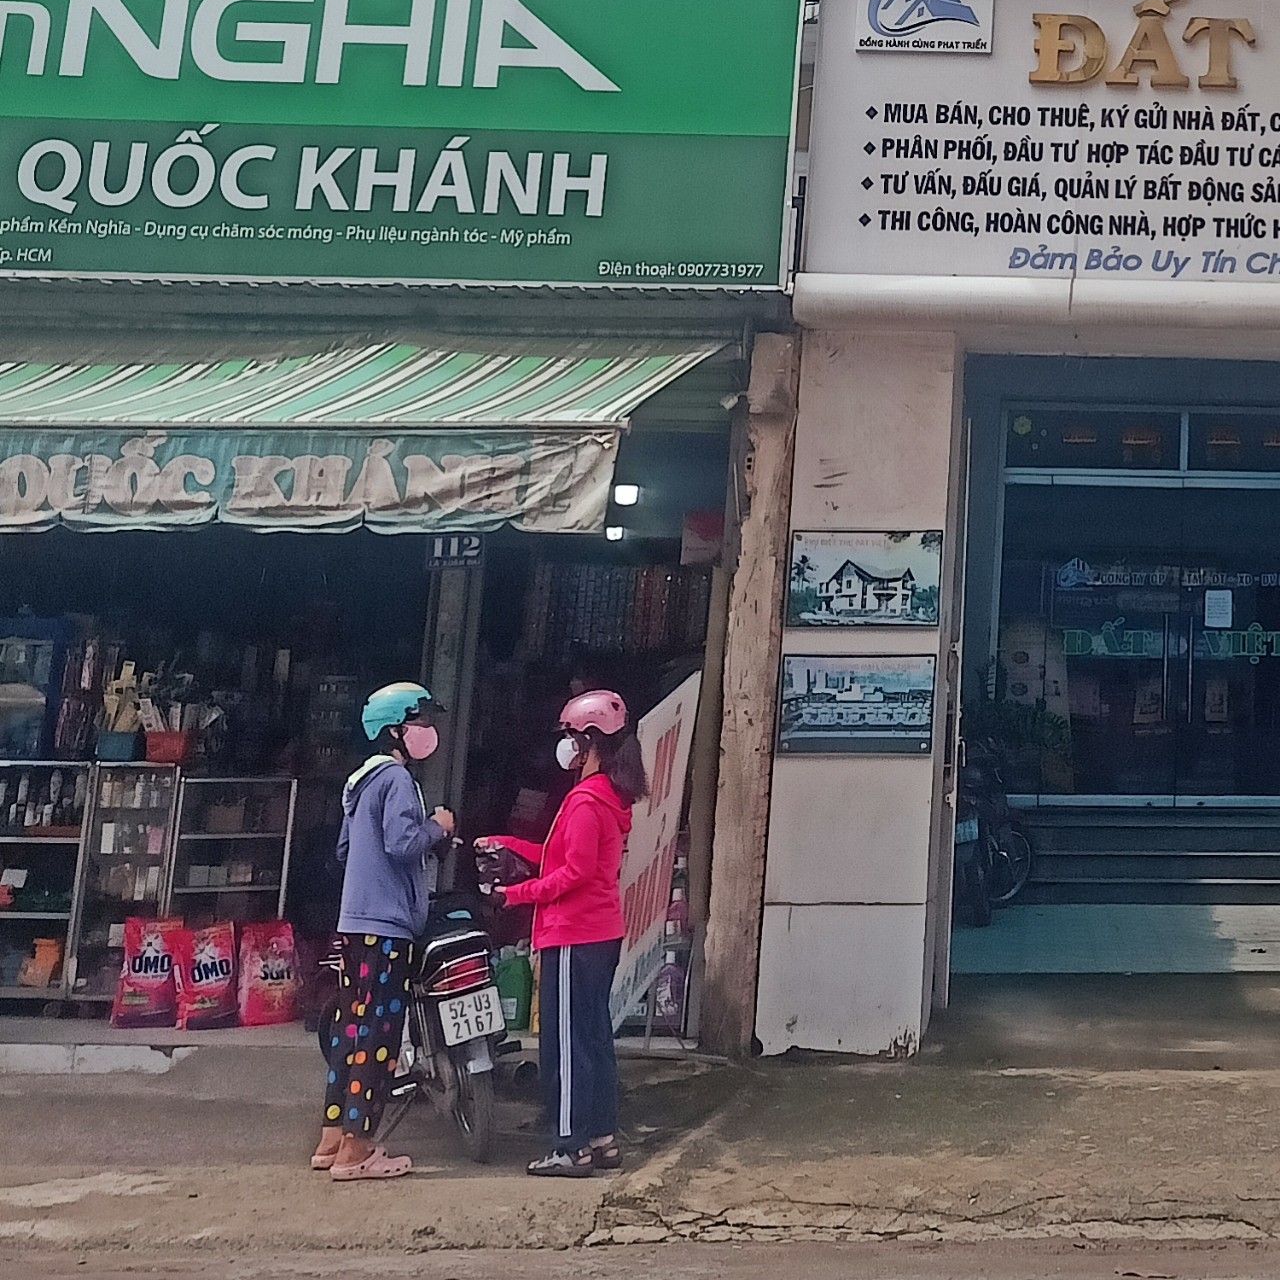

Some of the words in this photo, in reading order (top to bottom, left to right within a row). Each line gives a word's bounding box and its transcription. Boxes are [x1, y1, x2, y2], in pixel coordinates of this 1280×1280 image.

[884, 103, 928, 124] MUA
[936, 100, 983, 129] BÁN,
[988, 106, 1031, 127] CHO
[1037, 103, 1095, 131] THUÊ,
[1100, 104, 1130, 128] KÝ
[1134, 101, 1167, 129] GỬI
[1173, 106, 1215, 131] NHÀ
[1221, 103, 1266, 135] ĐẤT,
[881, 135, 939, 160] PHÂN
[943, 134, 998, 165] PHỐI,
[1003, 135, 1044, 163] ĐẦU
[1051, 139, 1080, 163] TƯ
[1087, 141, 1129, 168] HỢP
[1136, 140, 1173, 166] TÁC
[1180, 139, 1219, 167] ĐẦU
[1226, 143, 1256, 167] TƯ
[16, 123, 278, 216] QUỐC
[294, 136, 610, 217] KHÁNH
[881, 170, 909, 195] TƯ
[914, 168, 957, 199] VẤN,
[962, 169, 1001, 197] ĐẤU
[1007, 173, 1047, 201] GIÁ,
[1054, 171, 1109, 201] QUẢN
[1115, 175, 1138, 200] LÝ
[1144, 173, 1182, 201] BẤT
[1188, 177, 1244, 206] ĐỘNG
[86, 220, 131, 238] Nghĩa
[143, 221, 187, 240] Dụng
[190, 224, 209, 240] cụ
[212, 222, 255, 239] chăm
[258, 222, 284, 239] sóc
[287, 225, 333, 243] móng
[346, 226, 376, 243] Phụ
[379, 225, 407, 244] liệu
[410, 225, 460, 245] ngành
[463, 227, 488, 243] tóc
[500, 229, 525, 247] Mỹ
[526, 228, 571, 248] phẩm
[878, 210, 911, 231] THI
[917, 207, 980, 237] CÔNG,
[985, 208, 1041, 234] HOÀN
[1047, 210, 1104, 235] CÔNG
[1108, 210, 1157, 240] NHÀ,
[1163, 214, 1205, 241] HỢP
[1212, 212, 1267, 239] THỨC
[0, 248, 13, 264] p.
[16, 248, 52, 263] HCM
[598, 261, 632, 278] Điện
[635, 262, 675, 278] thoại:
[677, 263, 764, 278] 0907731977
[1008, 244, 1078, 270] Đảm
[1084, 245, 1143, 271] Bảo
[1151, 249, 1191, 278] Uy
[1201, 250, 1237, 274] Tín
[434, 536, 481, 558] 112
[132, 954, 172, 974] OMO
[191, 958, 232, 983] OMO
[449, 994, 491, 1020] 52-U3
[452, 1012, 493, 1039] 2167
